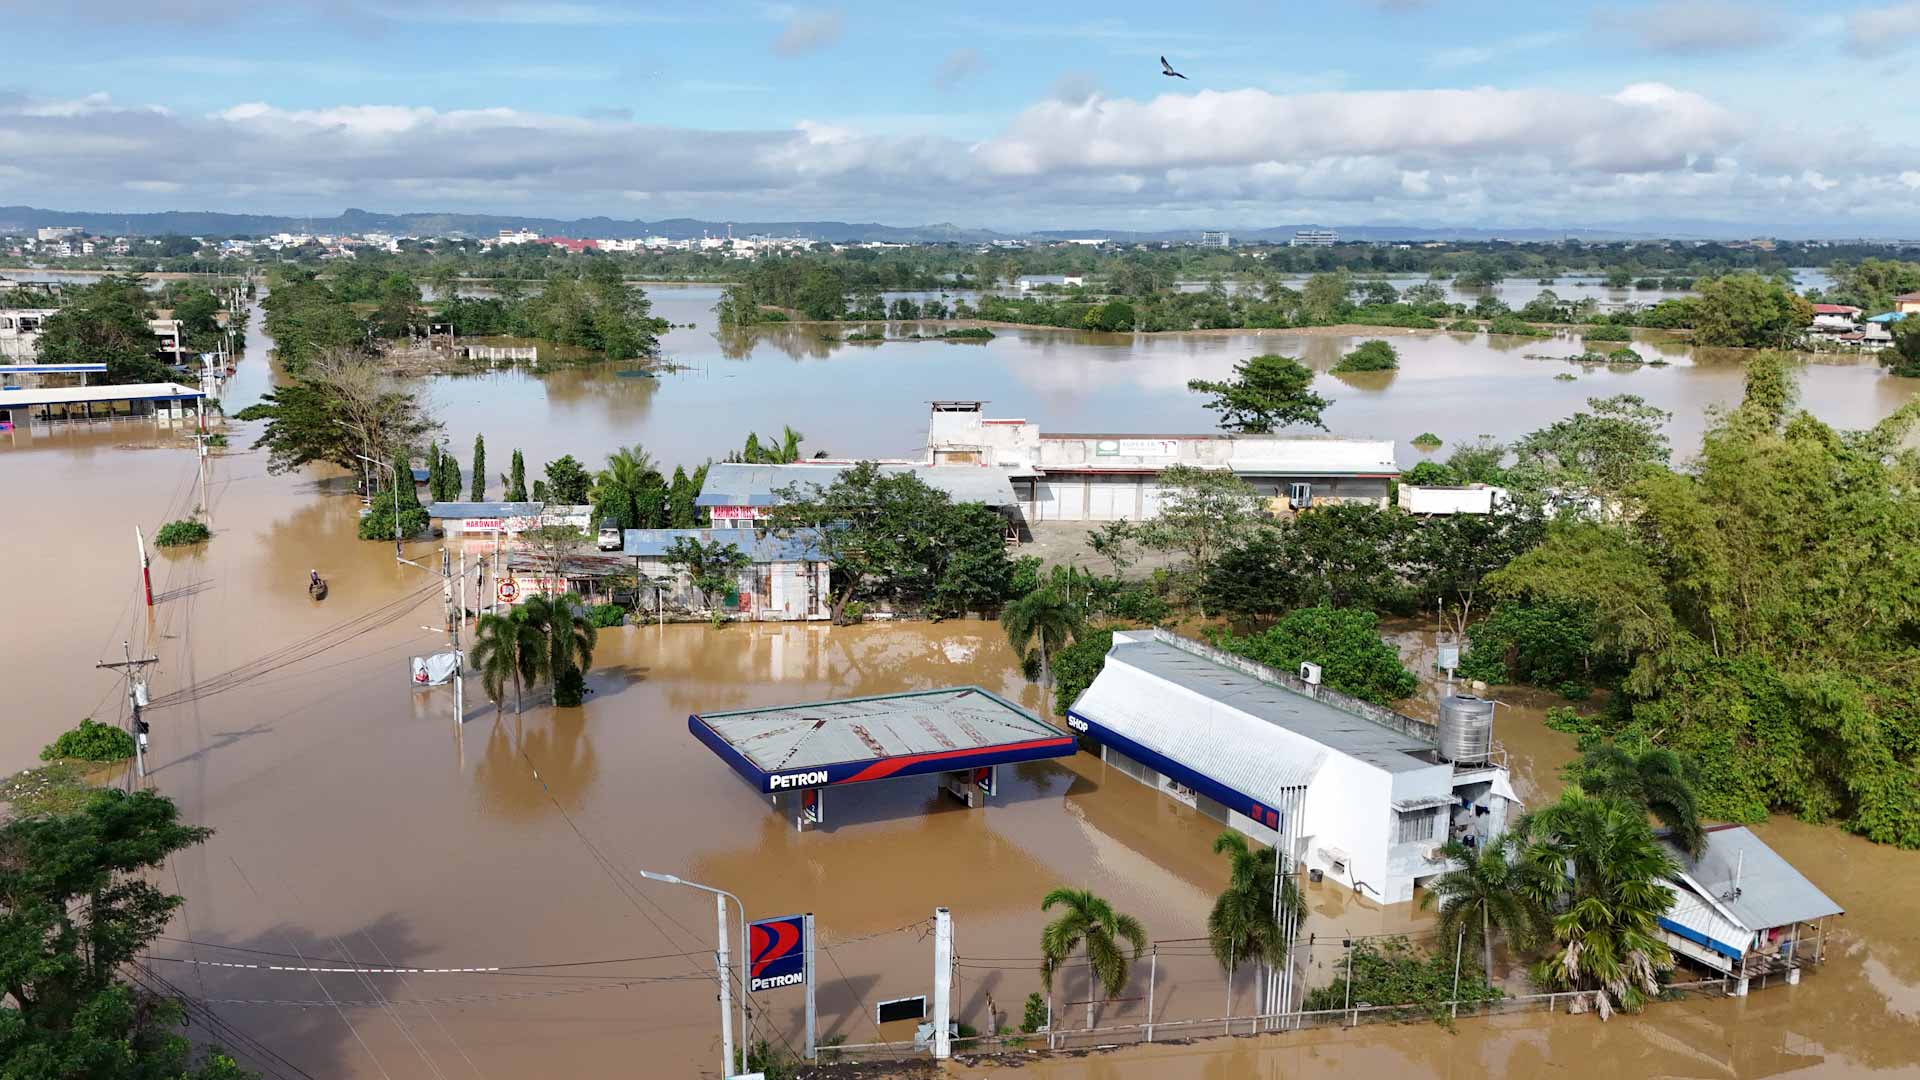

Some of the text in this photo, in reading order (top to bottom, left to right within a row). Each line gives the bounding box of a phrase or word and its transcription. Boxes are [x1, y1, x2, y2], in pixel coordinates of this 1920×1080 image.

[1068, 715, 1089, 732] SHOP
[769, 770, 828, 789] PETRON
[751, 972, 803, 991] PETRON
